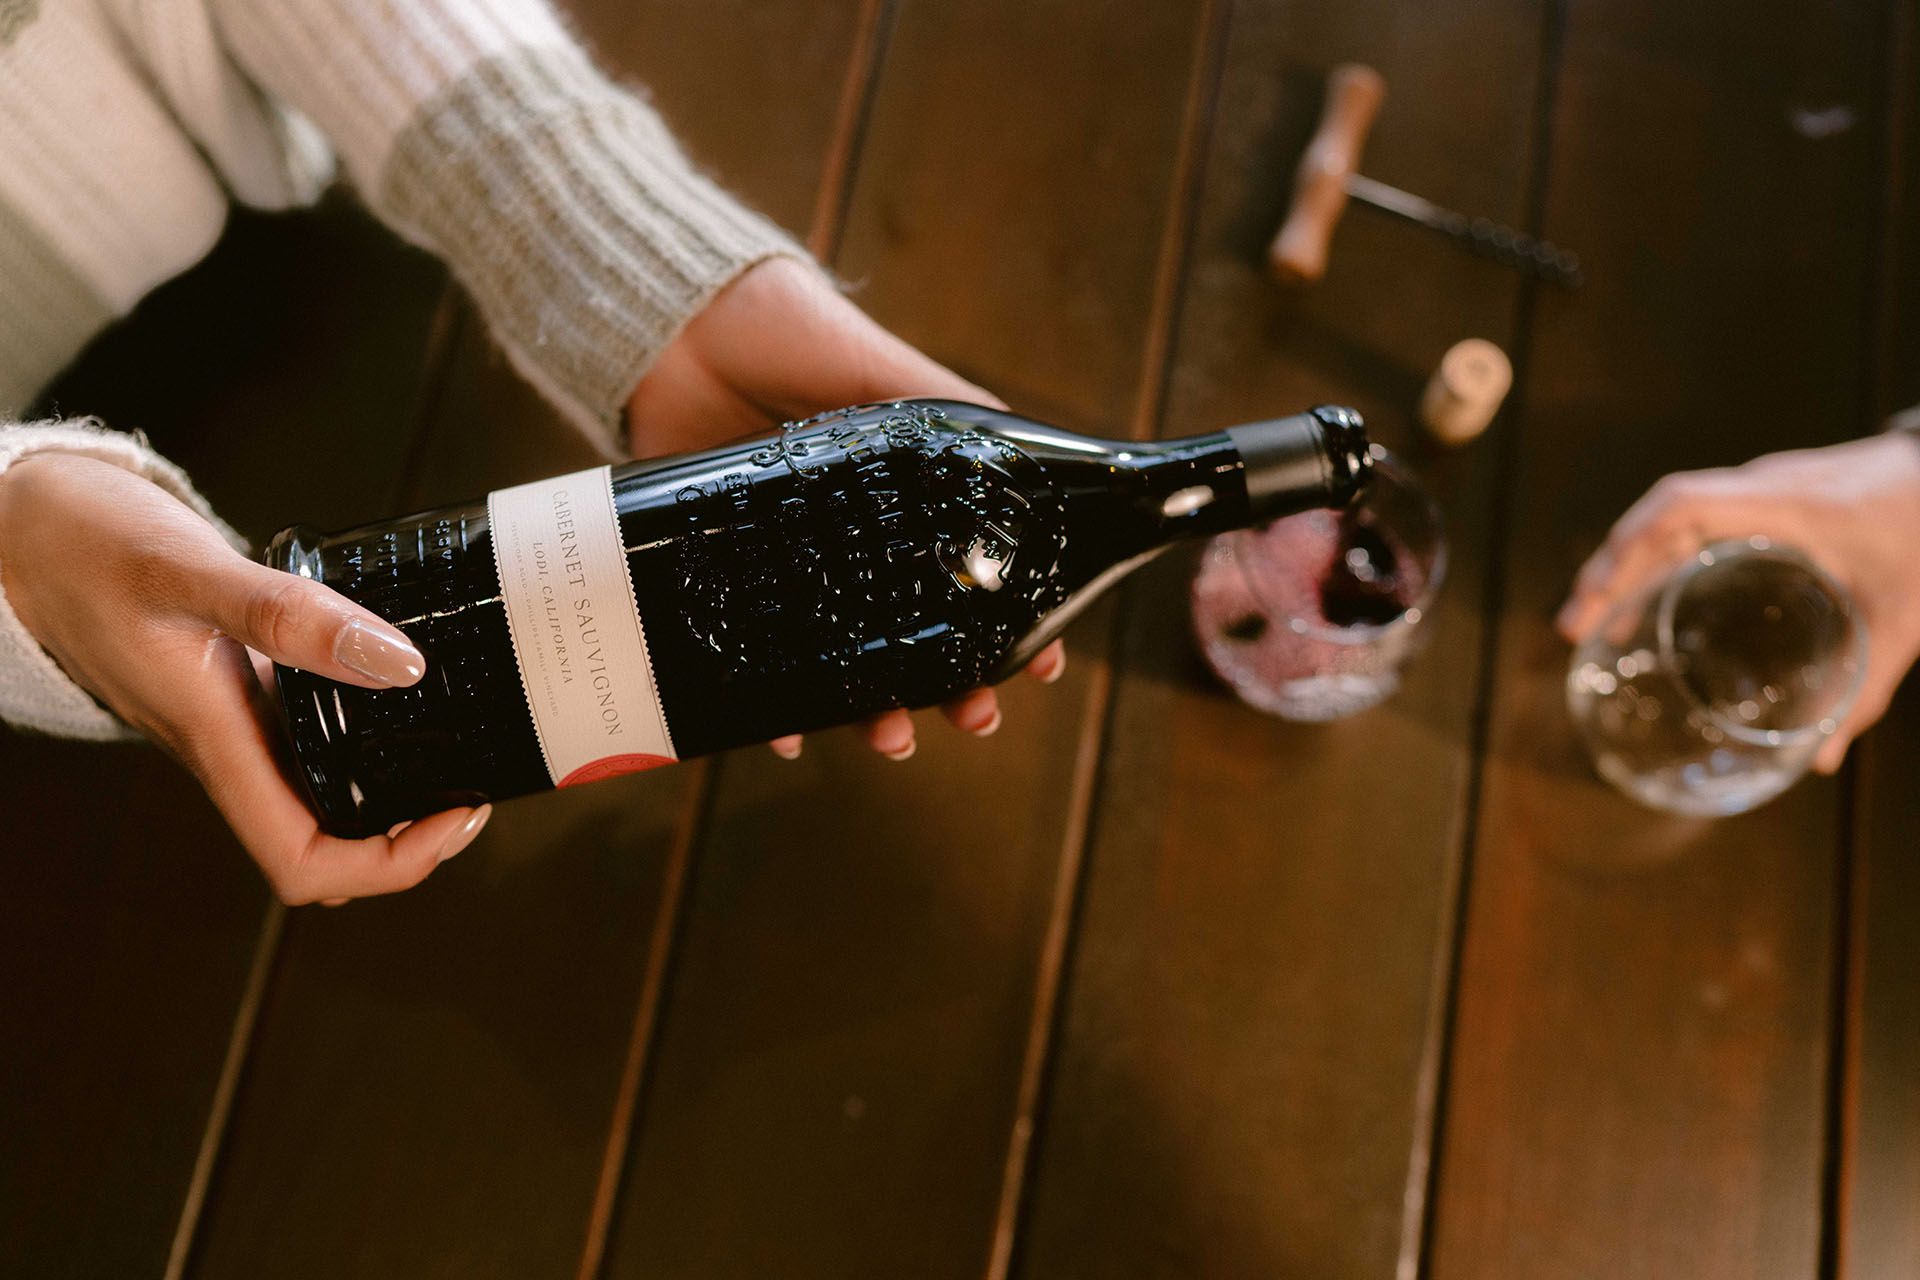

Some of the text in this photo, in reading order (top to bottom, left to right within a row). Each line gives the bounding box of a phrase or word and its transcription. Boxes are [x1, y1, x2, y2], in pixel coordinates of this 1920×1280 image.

[532, 542, 573, 684] LODI, CALIFORNIA
[552, 490, 623, 736] CABERNET SAUVIGNON
